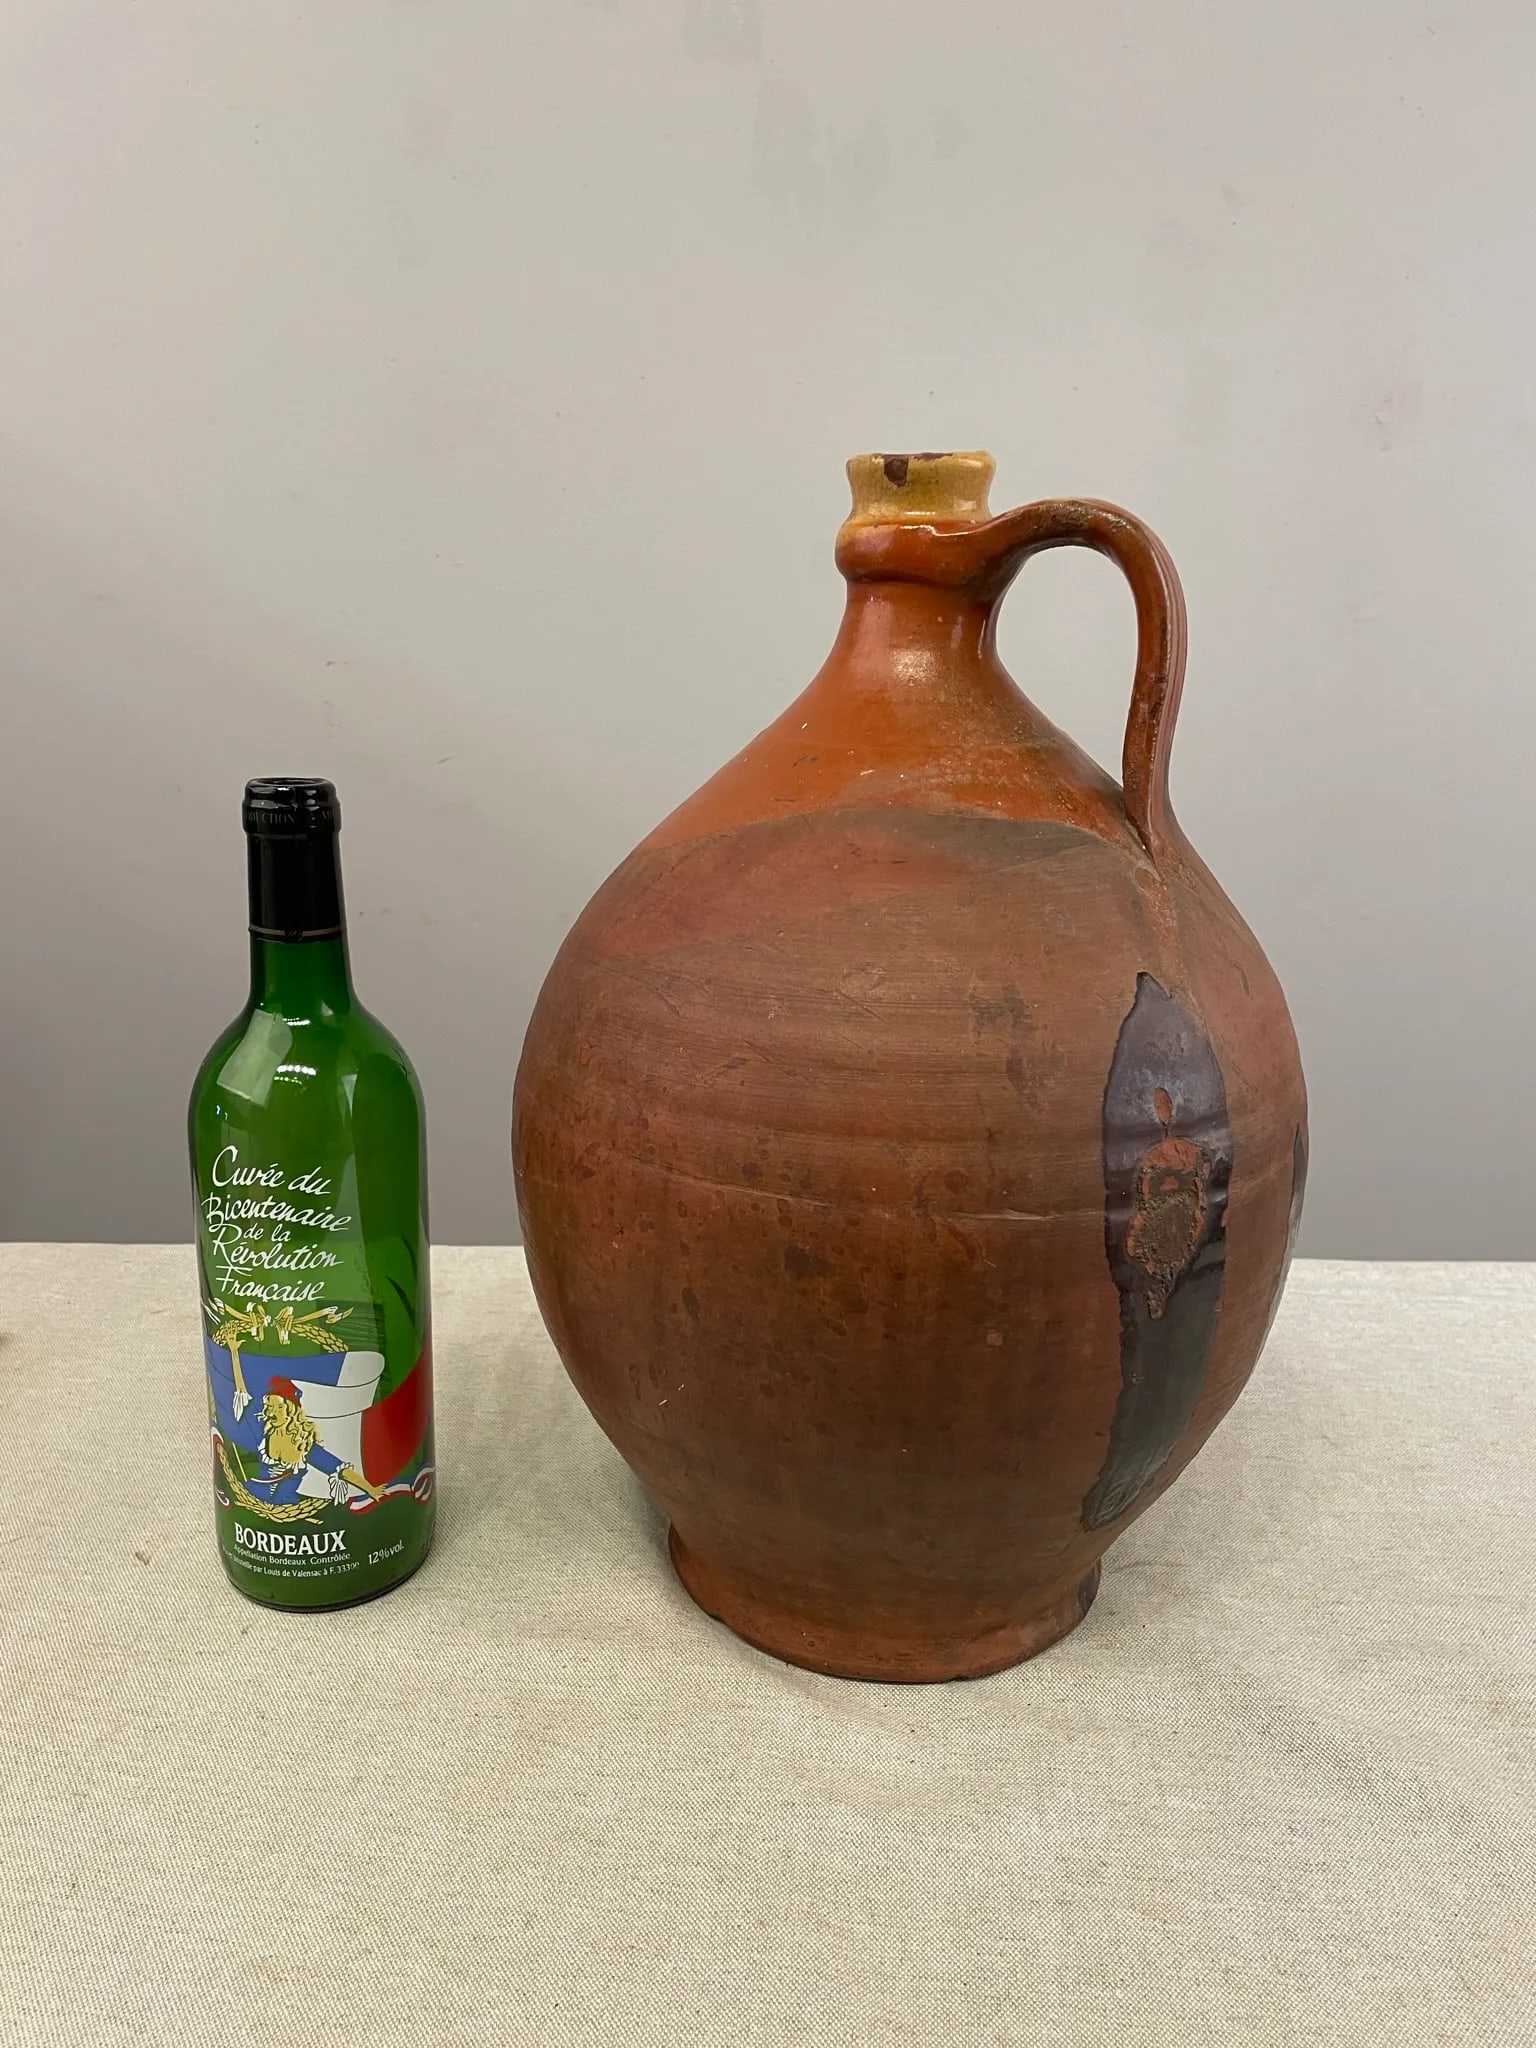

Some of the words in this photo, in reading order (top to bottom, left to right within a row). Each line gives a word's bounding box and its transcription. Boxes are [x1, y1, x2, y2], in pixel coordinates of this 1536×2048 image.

[212, 1145, 284, 1187] Cuvée
[288, 1166, 332, 1195] du
[201, 1192, 352, 1232] Bicentenaire
[212, 1223, 344, 1276] Révolution
[243, 1223, 264, 1240] de
[271, 1223, 291, 1242] la
[215, 1265, 325, 1303] Française
[233, 1543, 268, 1563] Appellation
[269, 1555, 307, 1566] Bordeaux
[309, 1552, 351, 1565] Contrôlée
[234, 1521, 347, 1556] BORDEAUX
[263, 1567, 281, 1577] Louis
[282, 1569, 291, 1577] de
